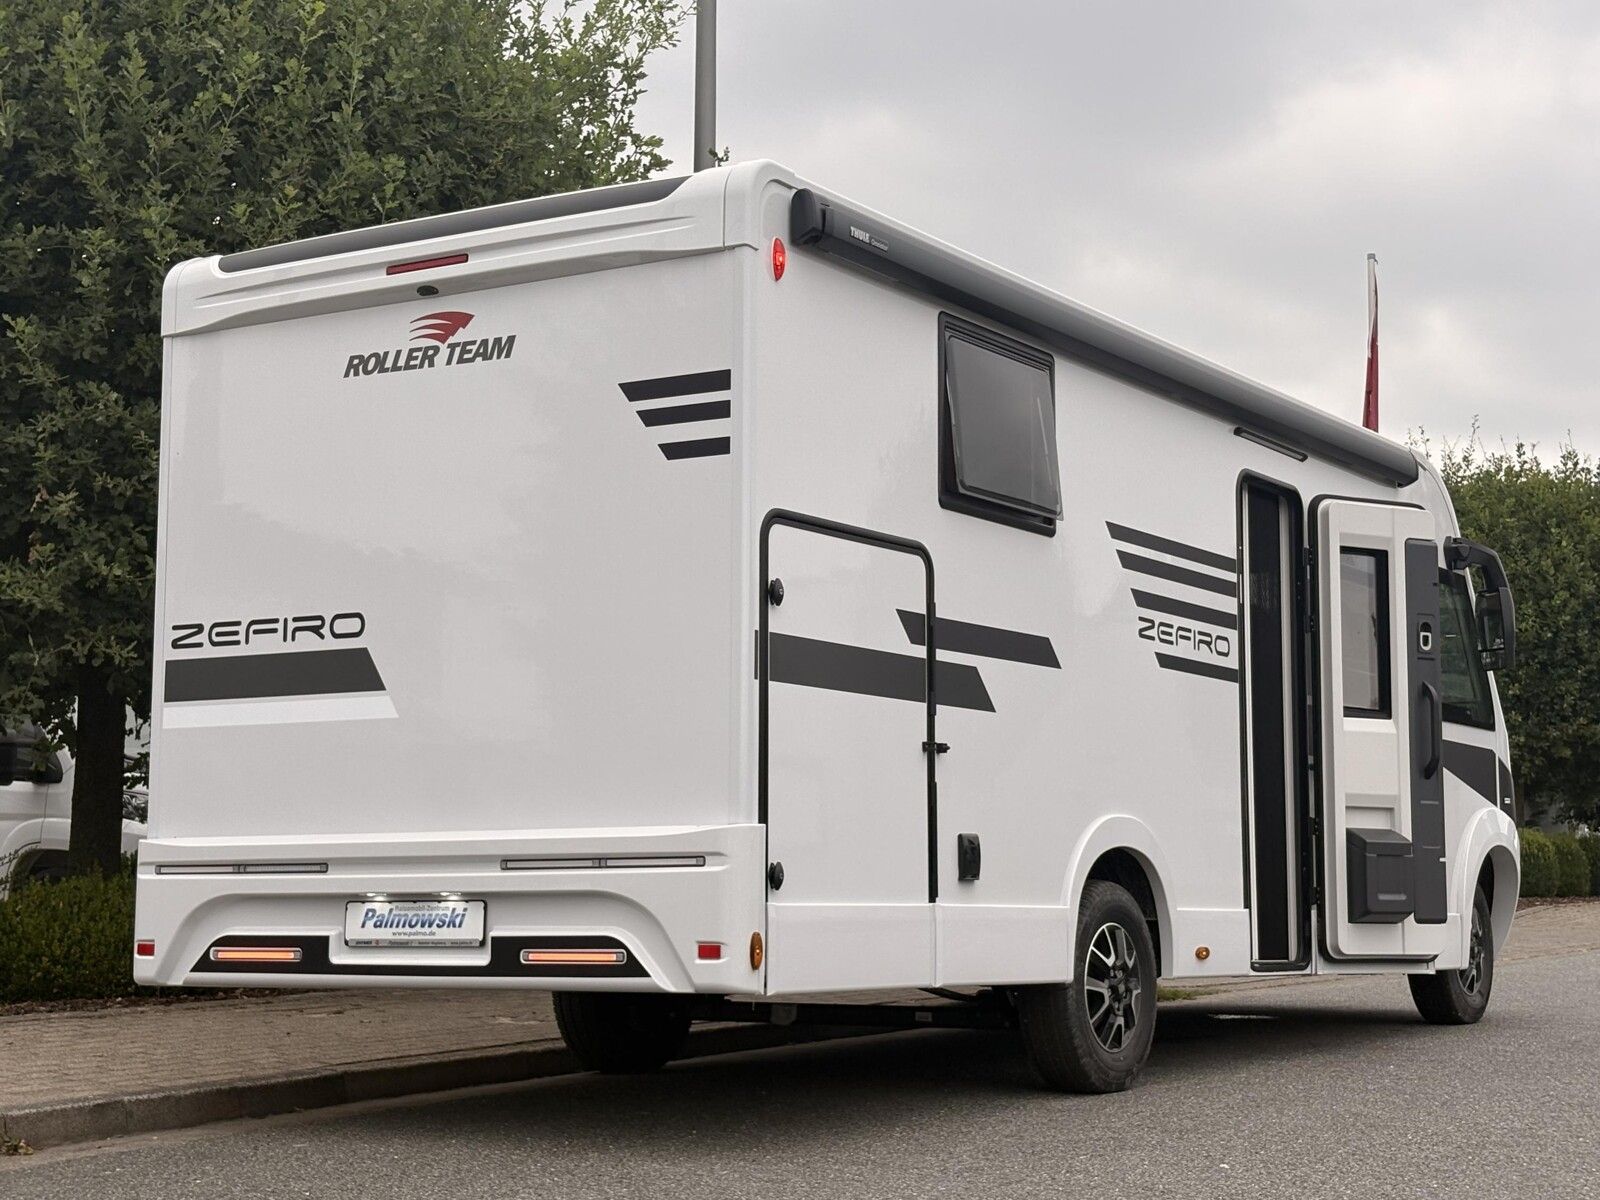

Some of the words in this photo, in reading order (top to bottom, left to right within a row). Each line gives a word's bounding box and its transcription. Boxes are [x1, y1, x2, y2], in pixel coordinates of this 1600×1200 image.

[343, 344, 440, 378] ROLLER
[445, 335, 517, 366] TEAM
[171, 612, 366, 649] ZEFIRO
[1138, 616, 1231, 657] ZEFIRO
[360, 907, 468, 929] Palmowski
